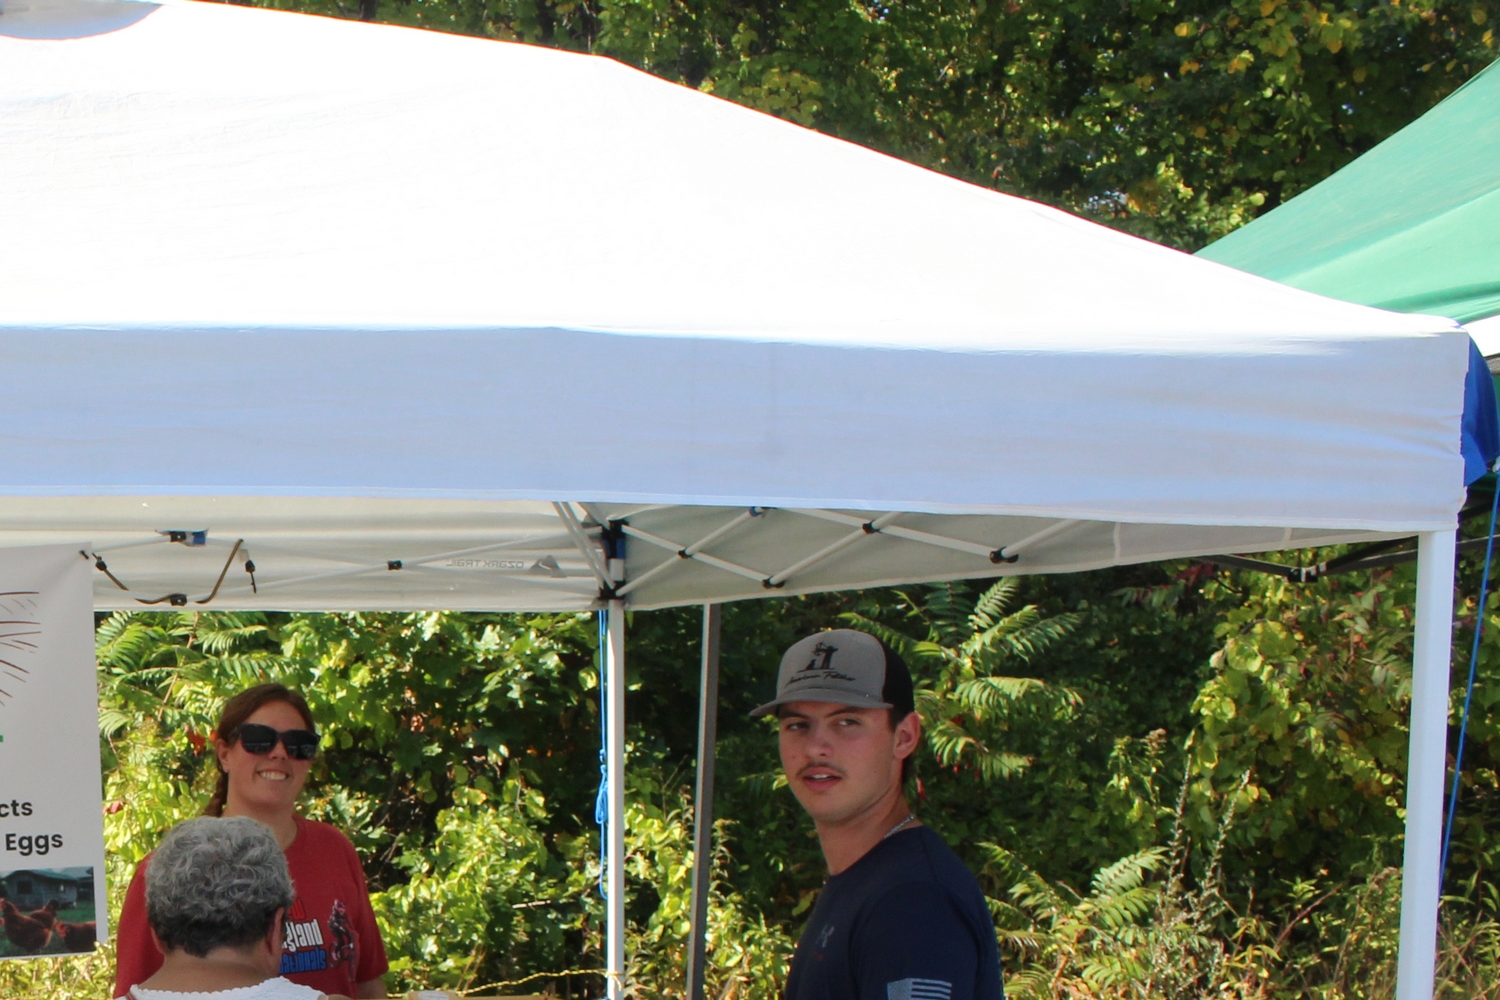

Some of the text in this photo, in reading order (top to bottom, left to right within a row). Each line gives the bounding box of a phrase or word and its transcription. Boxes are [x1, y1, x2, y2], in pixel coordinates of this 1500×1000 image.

[5, 833, 64, 857] Eggs
[283, 918, 323, 952] gland
[279, 948, 327, 974] ationals
